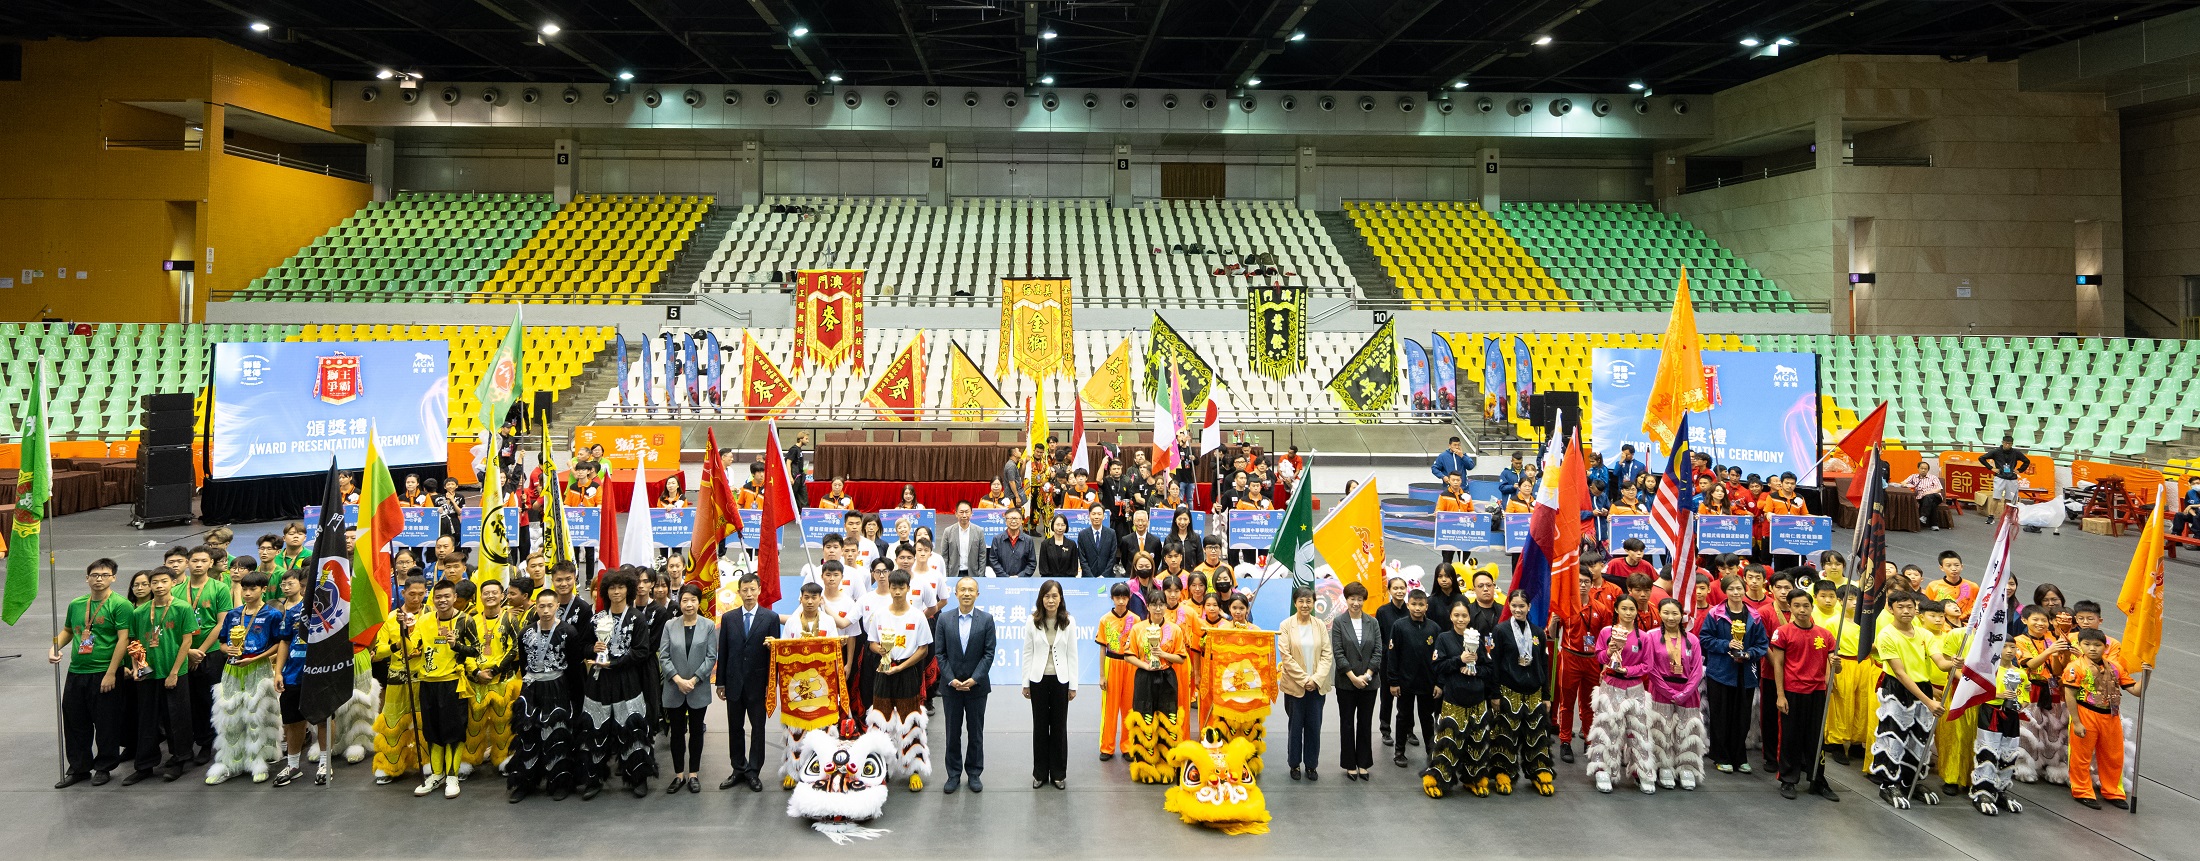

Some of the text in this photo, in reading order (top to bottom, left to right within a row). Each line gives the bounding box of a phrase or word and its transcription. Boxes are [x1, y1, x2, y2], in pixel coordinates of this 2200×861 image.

[560, 154, 566, 164] 6
[934, 158, 941, 167] 7
[1120, 160, 1126, 168] 8
[1490, 164, 1496, 172] 9
[670, 308, 678, 318] 5
[1376, 312, 1387, 322] 10
[1028, 311, 1050, 356] 金獅
[327, 370, 350, 380] 獅王
[327, 381, 350, 392] 爭霸
[306, 418, 368, 438] 頒獎禮
[250, 443, 286, 456] AWARD
[291, 436, 365, 452] PRESENTATION
[1728, 449, 1784, 464] CEREMONY
[332, 661, 344, 672] LO
